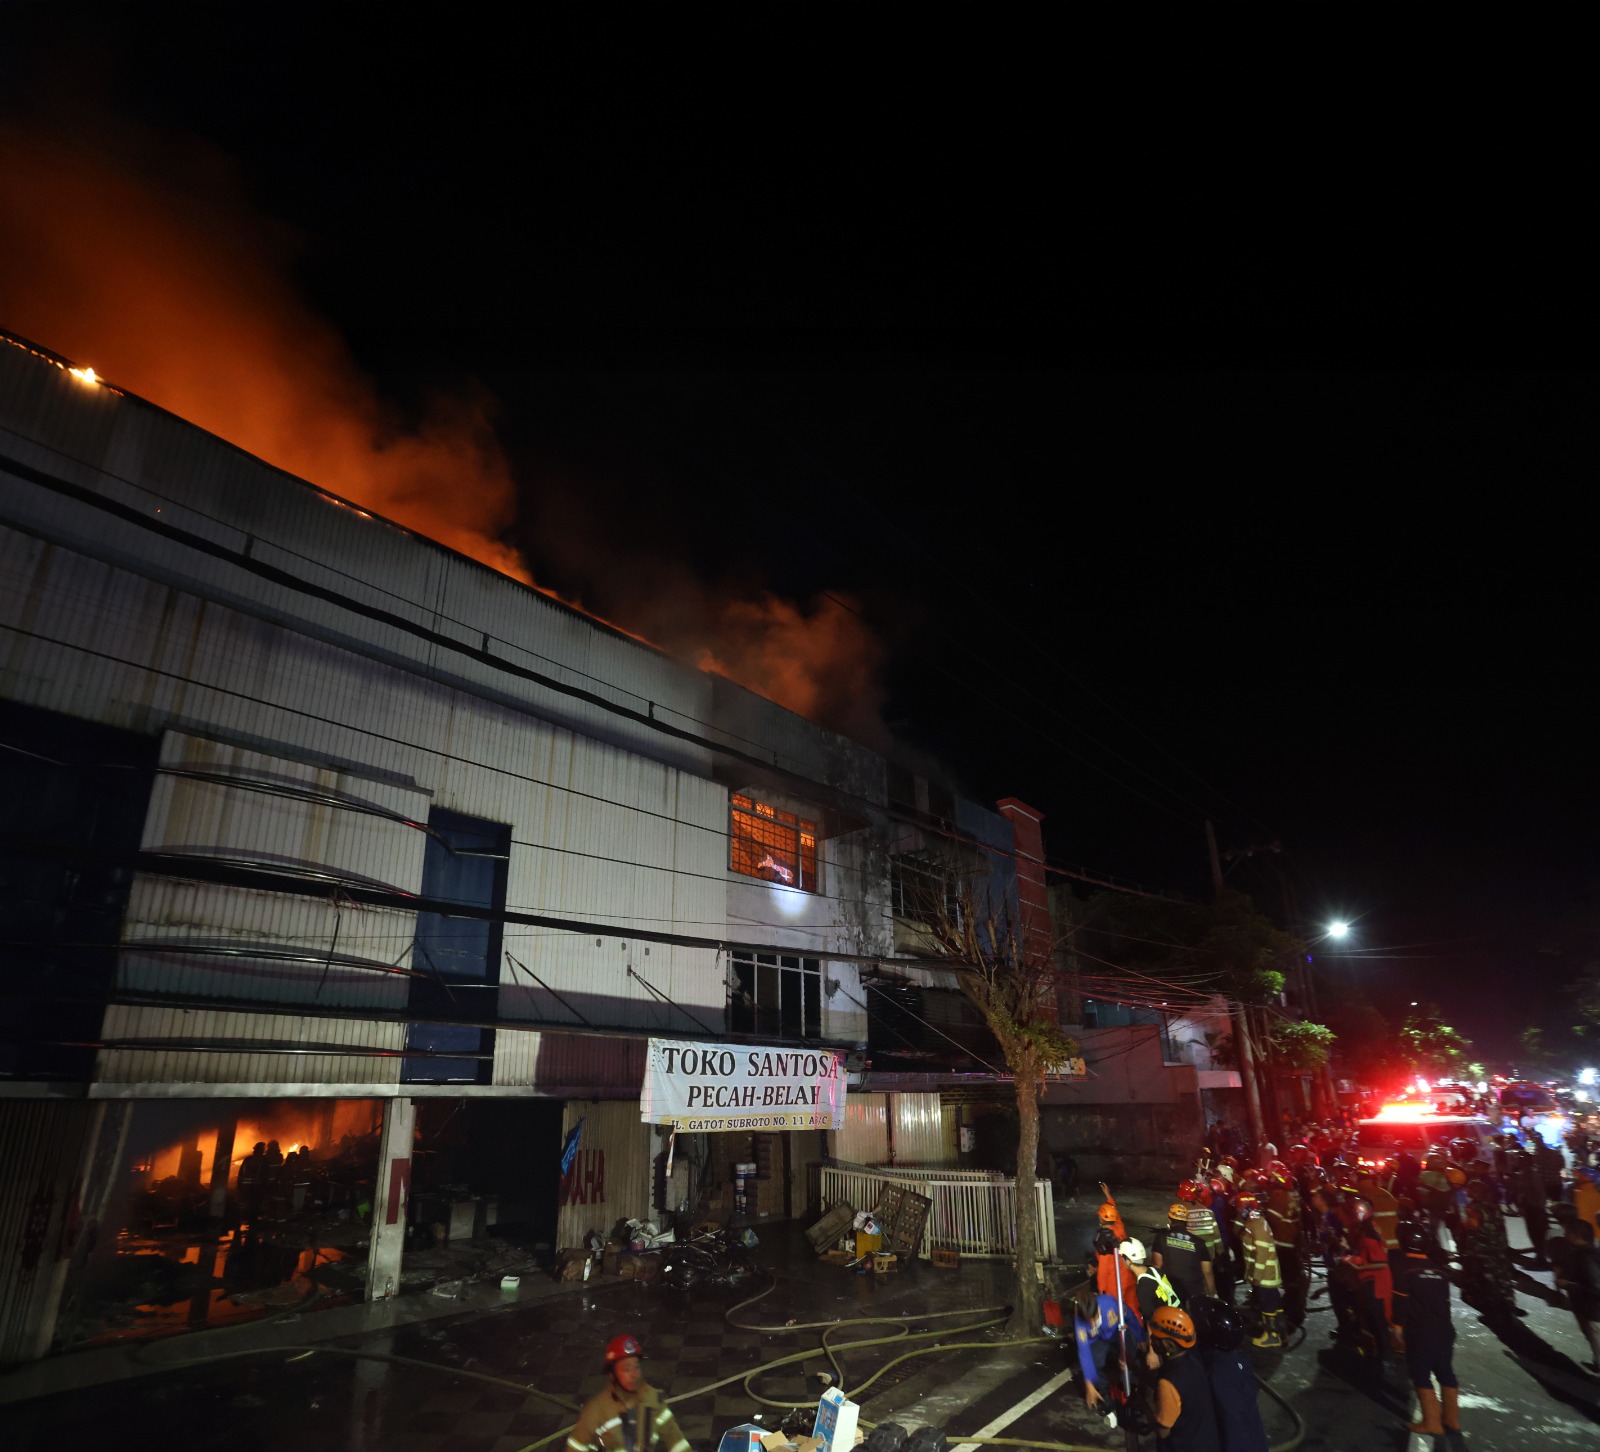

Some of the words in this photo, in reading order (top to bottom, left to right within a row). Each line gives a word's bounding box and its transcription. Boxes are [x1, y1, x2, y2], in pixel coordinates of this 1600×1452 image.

[662, 1048, 736, 1076] TOKO
[747, 1052, 838, 1079] SANTOSA
[687, 1086, 821, 1107] PECAH-BELAH
[688, 1119, 724, 1130] GATOT
[726, 1117, 770, 1129] SUBROTO
[772, 1116, 788, 1126] NO.
[792, 1116, 804, 1125] 11
